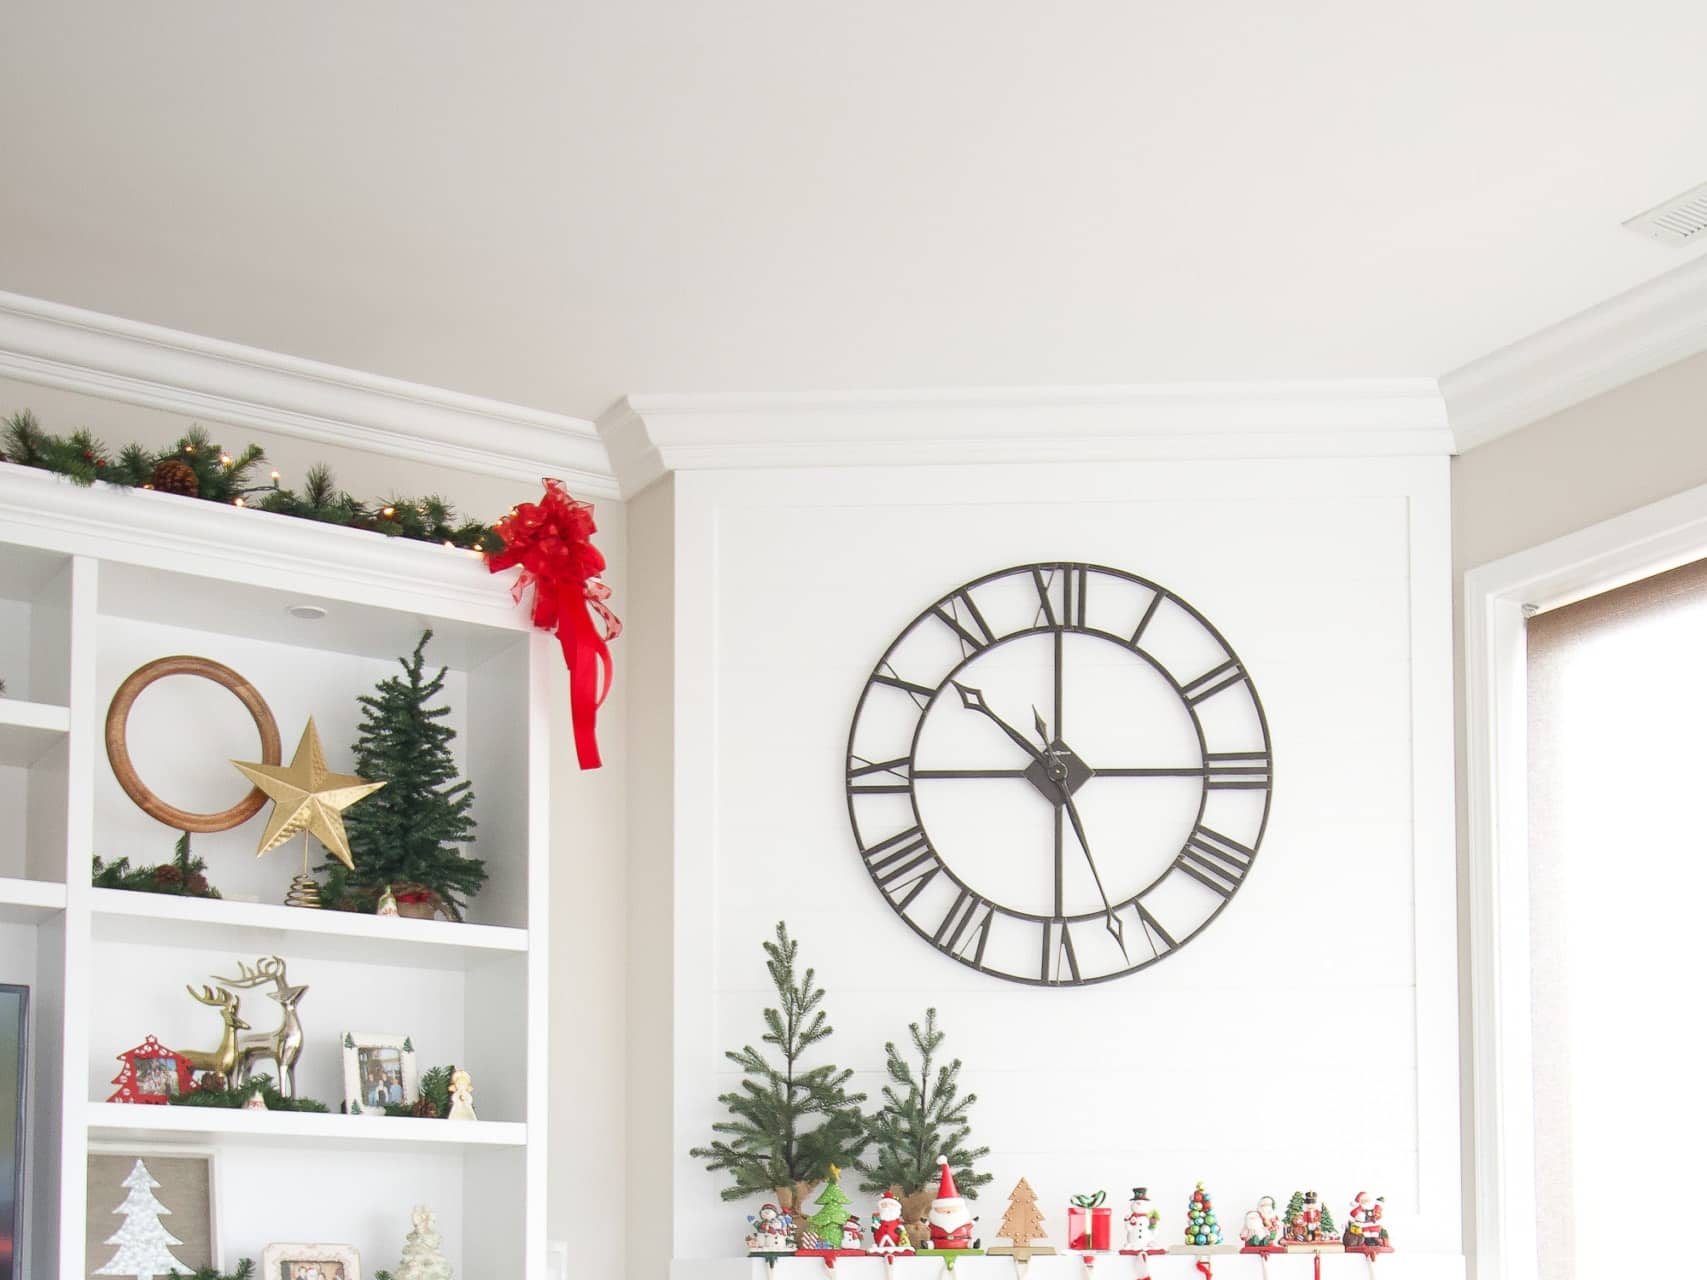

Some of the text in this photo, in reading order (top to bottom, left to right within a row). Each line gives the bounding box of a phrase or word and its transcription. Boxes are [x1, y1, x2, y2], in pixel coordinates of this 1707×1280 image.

[931, 589, 999, 658] XI
[1031, 564, 1089, 630] XII
[1180, 656, 1249, 707] II
[847, 754, 914, 794] IX
[1204, 752, 1271, 790] III
[1041, 919, 1082, 985] VI
